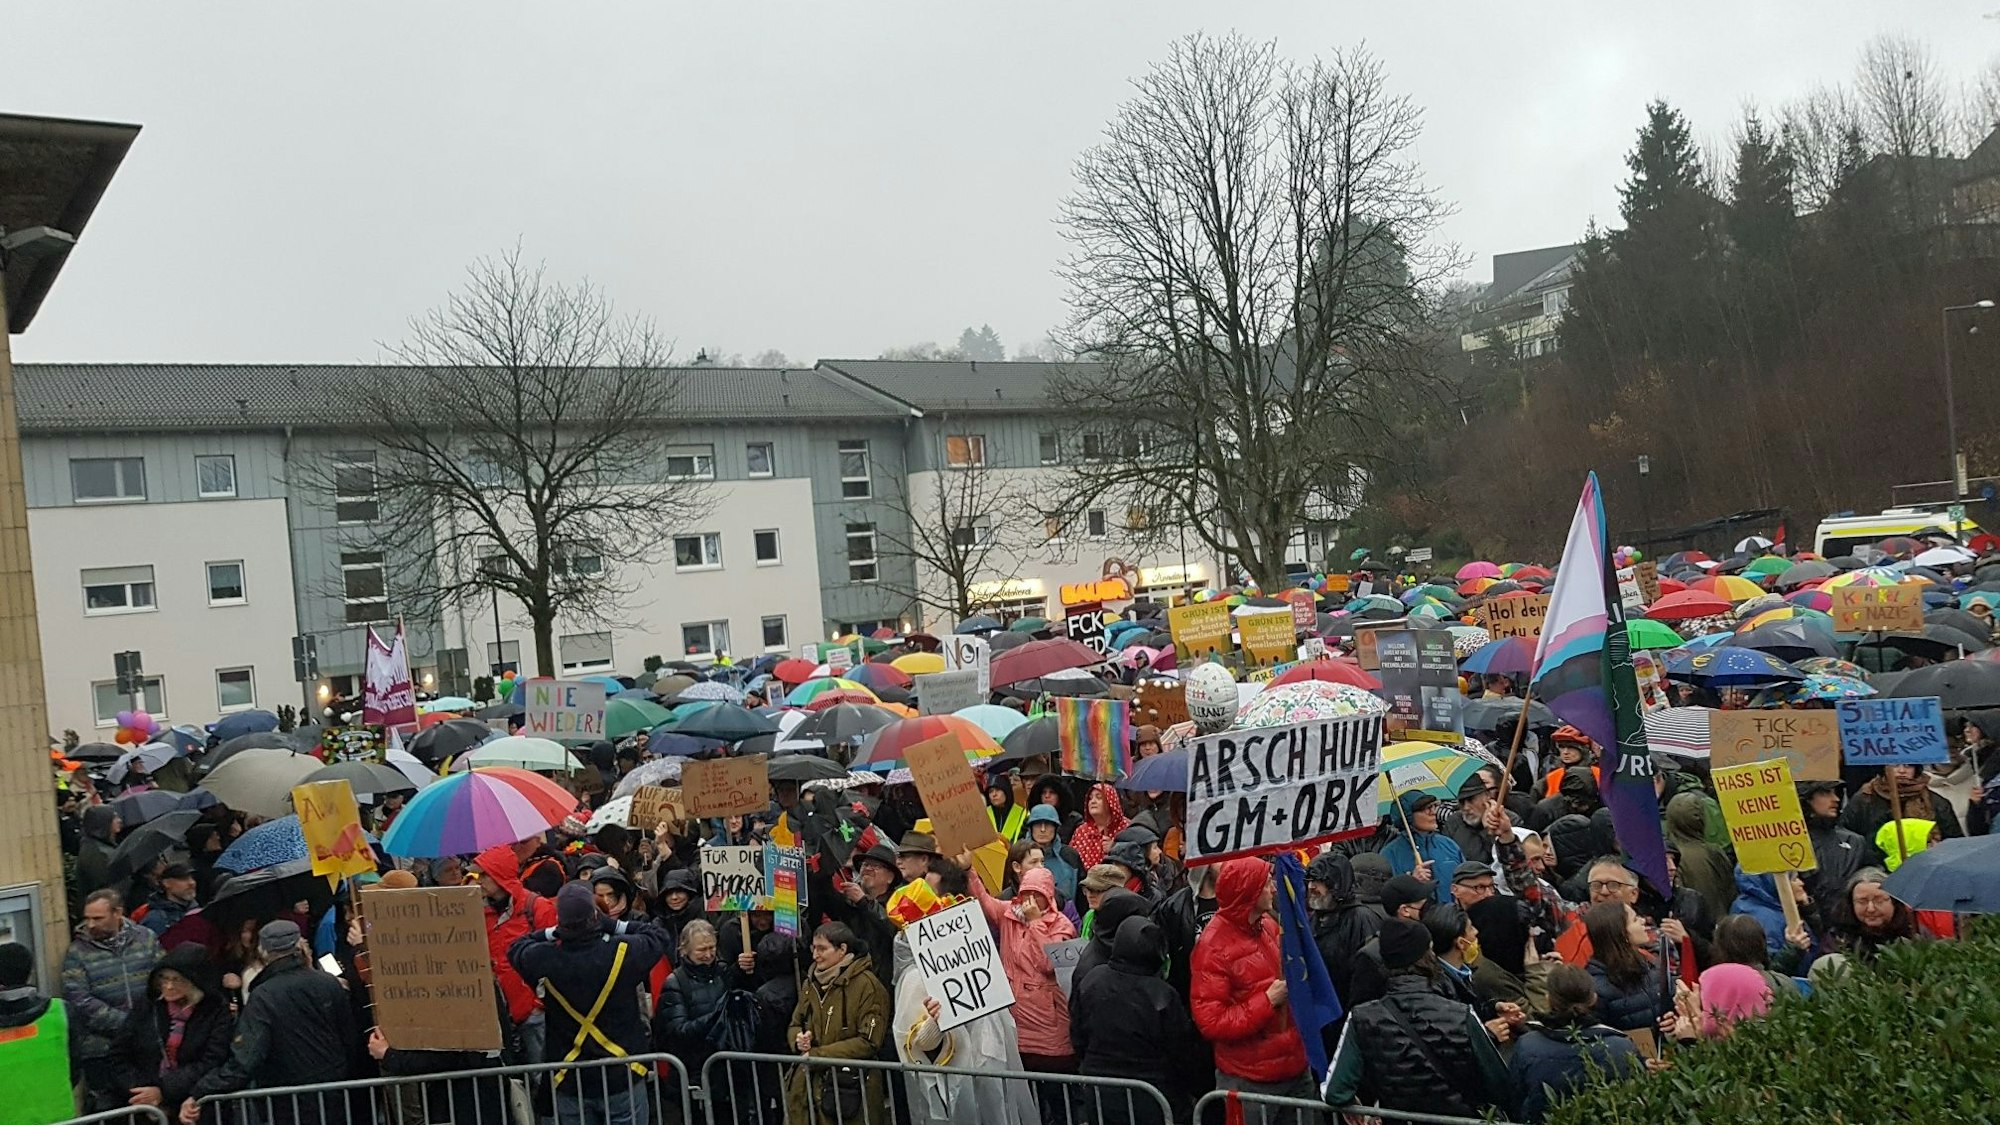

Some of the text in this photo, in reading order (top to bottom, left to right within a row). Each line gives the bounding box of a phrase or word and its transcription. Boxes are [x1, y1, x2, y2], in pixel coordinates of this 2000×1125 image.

[1210, 605, 1226, 614] IST
[1067, 611, 1105, 637] FCK
[1200, 622, 1229, 632] bunten
[1248, 615, 1291, 627] GRÜN IST
[1266, 631, 1294, 640] bunten
[1076, 637, 1106, 655] FD
[536, 686, 577, 707] NIE
[529, 710, 604, 734] WIEDER!
[1752, 717, 1797, 732] FICK
[1762, 735, 1794, 749] DIE
[1847, 737, 1899, 757] SAGE
[1898, 733, 1939, 755] NEIN
[1189, 731, 1308, 802] ARSCH
[1716, 767, 1782, 792] HASS IST
[633, 786, 661, 800] AUF
[1737, 794, 1780, 814] KEINE
[1732, 819, 1807, 841] MEINUNG!
[702, 850, 729, 864] FÜR
[768, 855, 803, 869] IST JETZT!
[428, 895, 466, 918] Hass
[375, 927, 400, 945] und
[918, 909, 973, 946] Alexej
[918, 935, 991, 978] Nawalny
[942, 967, 991, 1017] RIP
